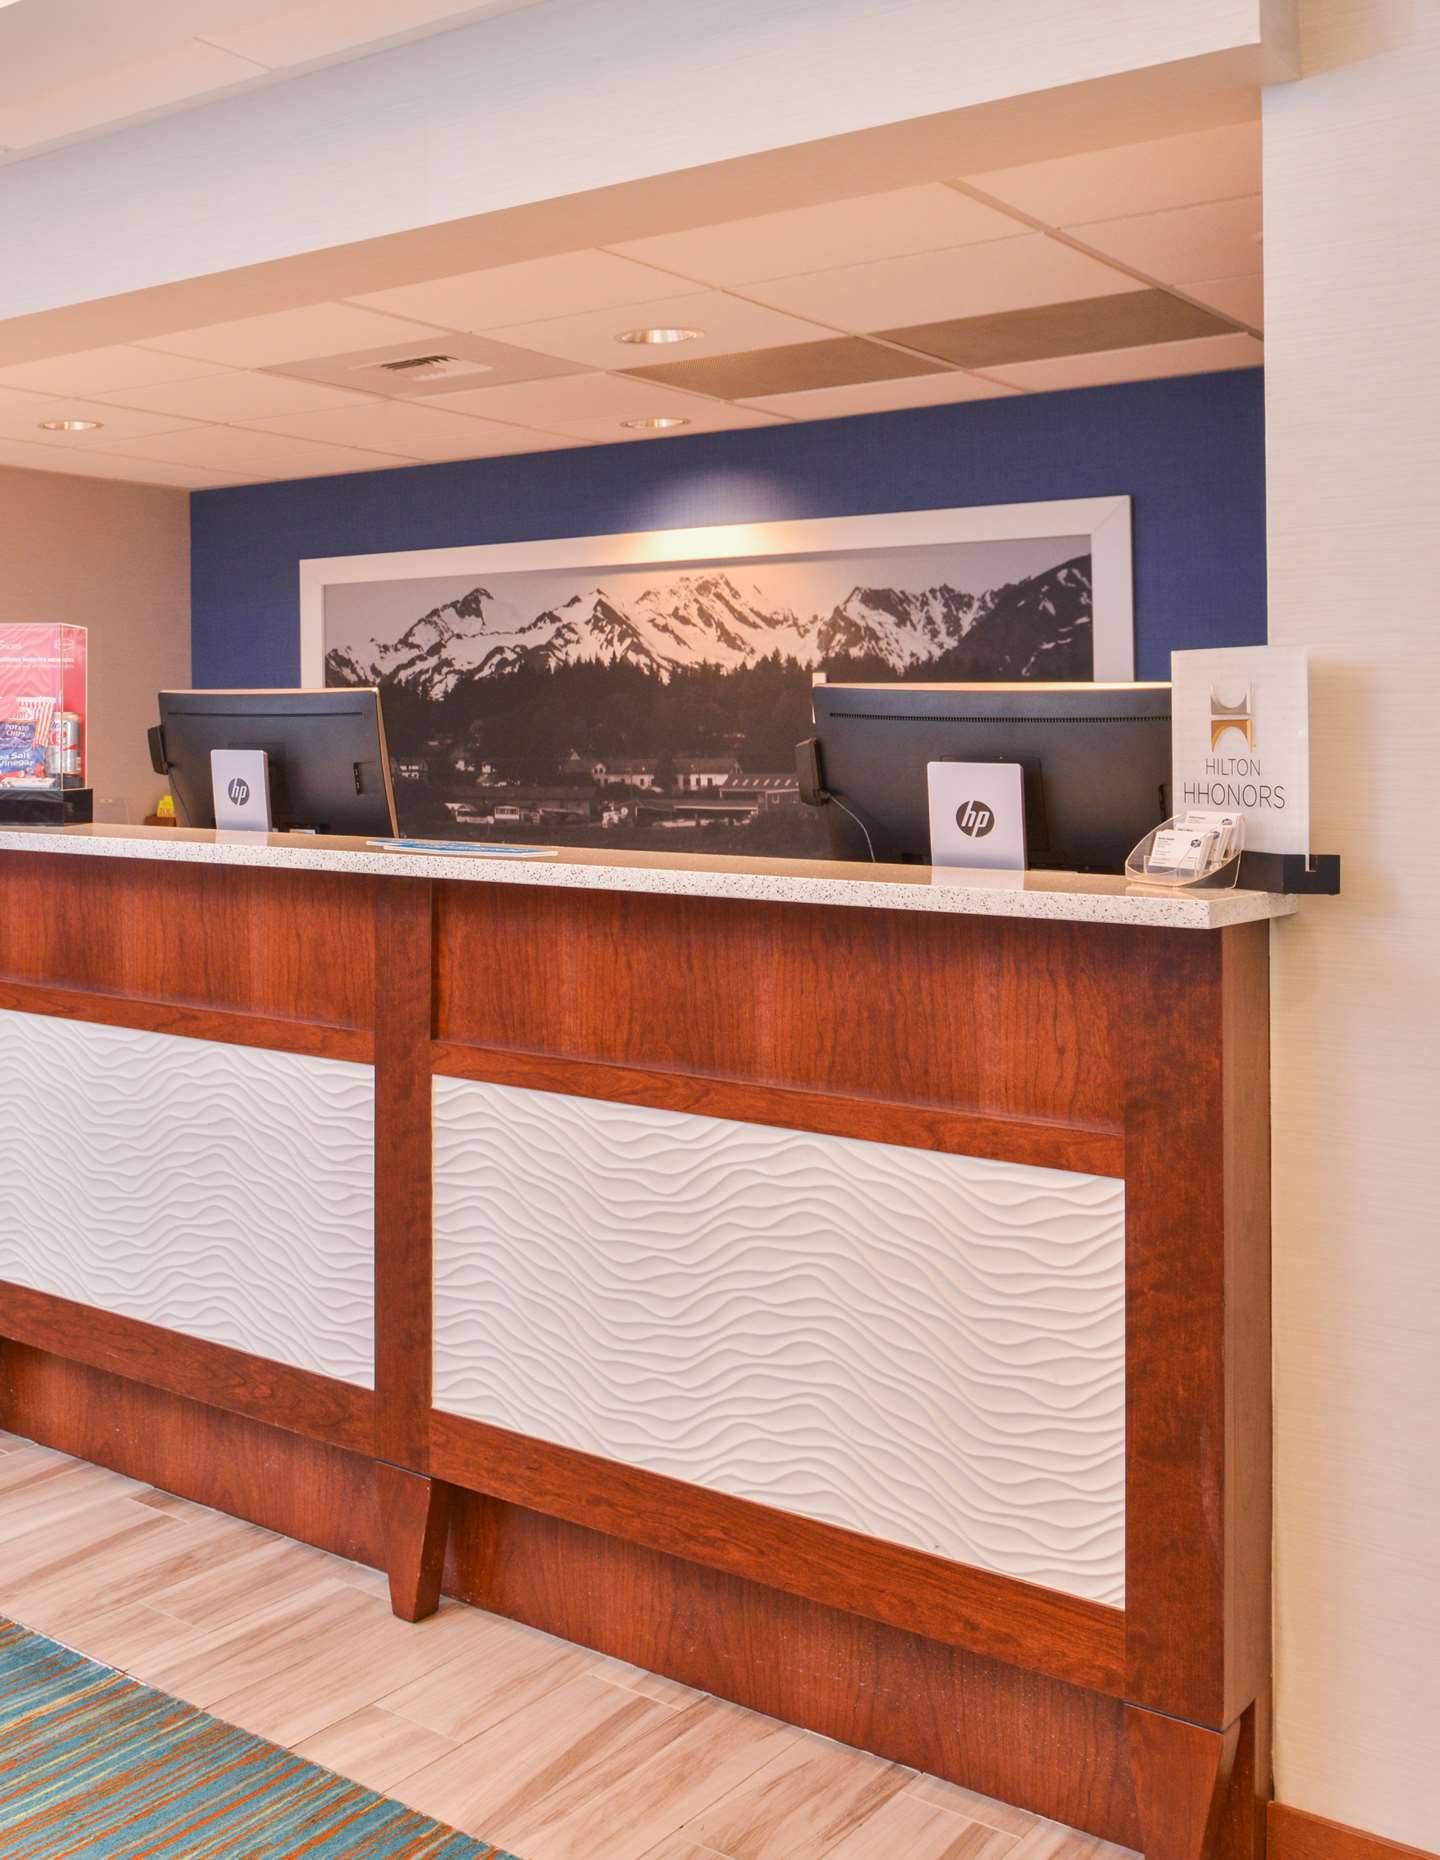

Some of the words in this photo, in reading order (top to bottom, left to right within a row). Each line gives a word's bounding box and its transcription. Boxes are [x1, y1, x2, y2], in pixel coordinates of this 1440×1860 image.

[11, 751, 31, 759] Salt
[1205, 758, 1261, 776] HILTON
[230, 777, 248, 805] hp
[1183, 782, 1286, 809] HHONORS
[960, 799, 991, 838] hp
